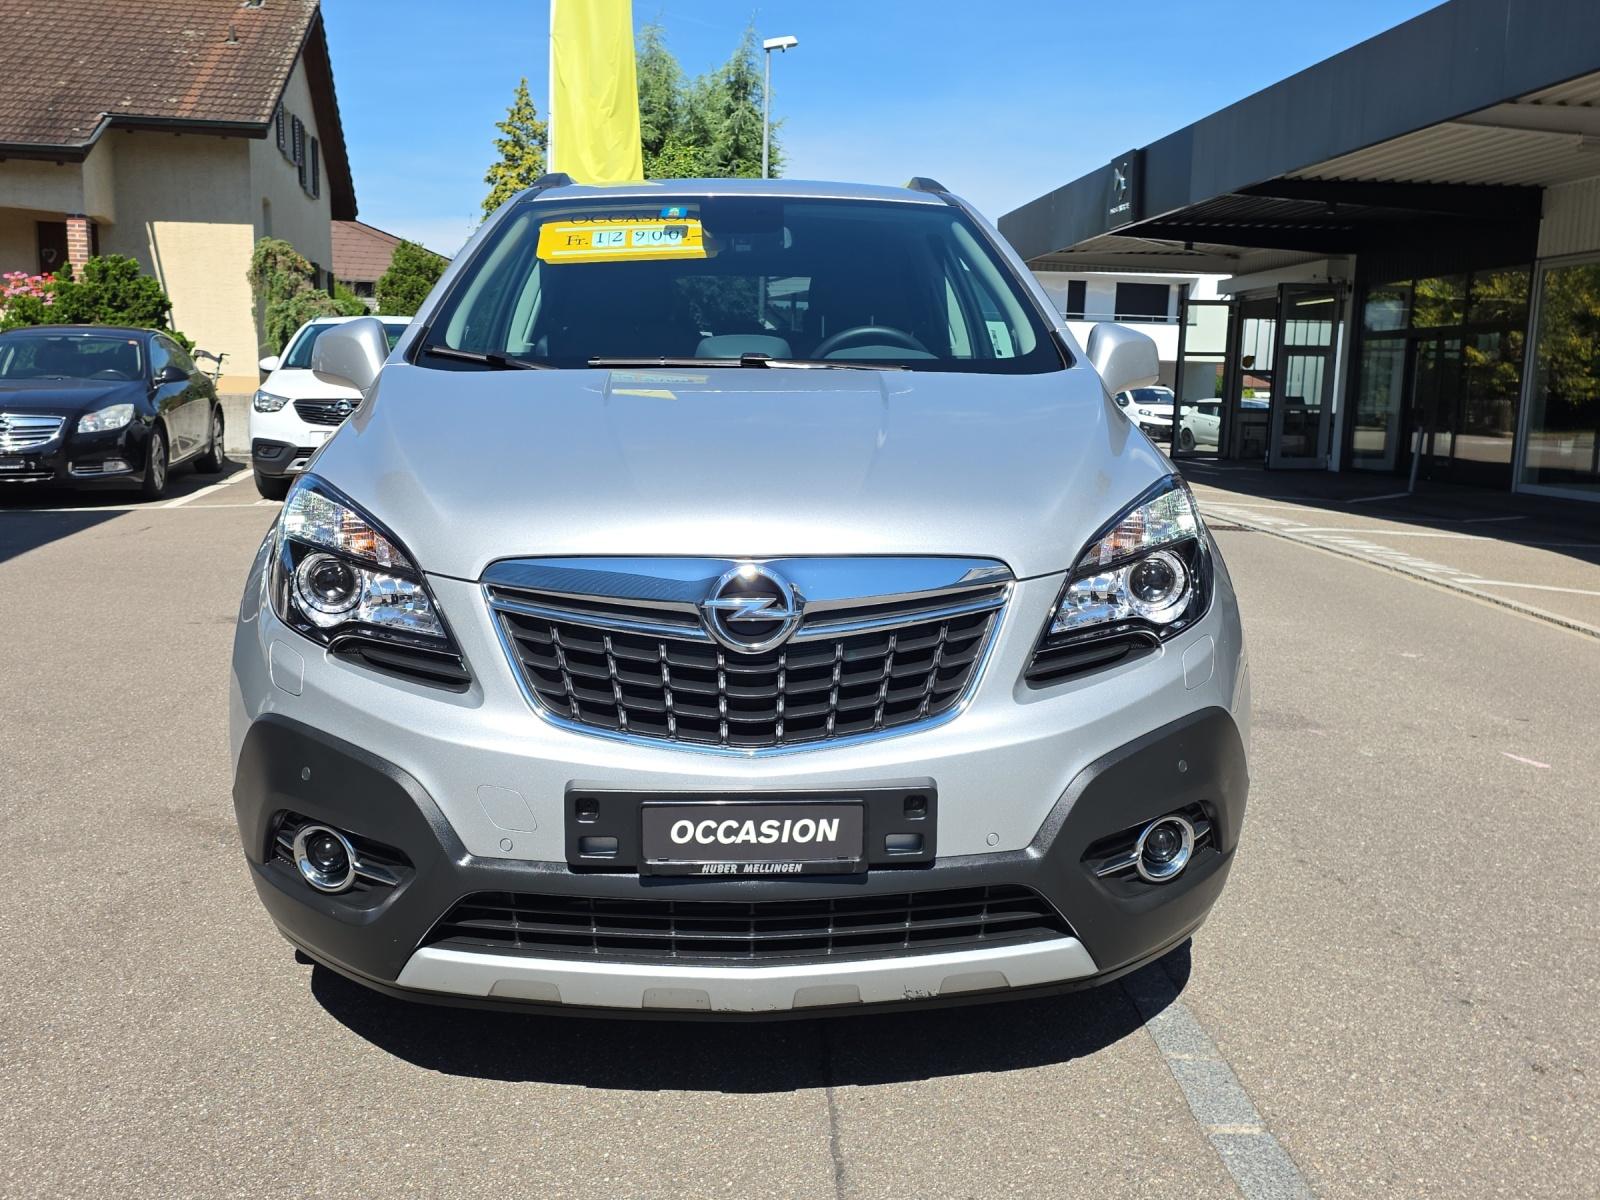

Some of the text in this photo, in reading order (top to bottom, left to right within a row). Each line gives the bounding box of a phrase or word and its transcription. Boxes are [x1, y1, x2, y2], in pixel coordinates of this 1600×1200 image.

[670, 818, 840, 845] OCCASION
[702, 862, 803, 875] HUBER MELLINGEN
